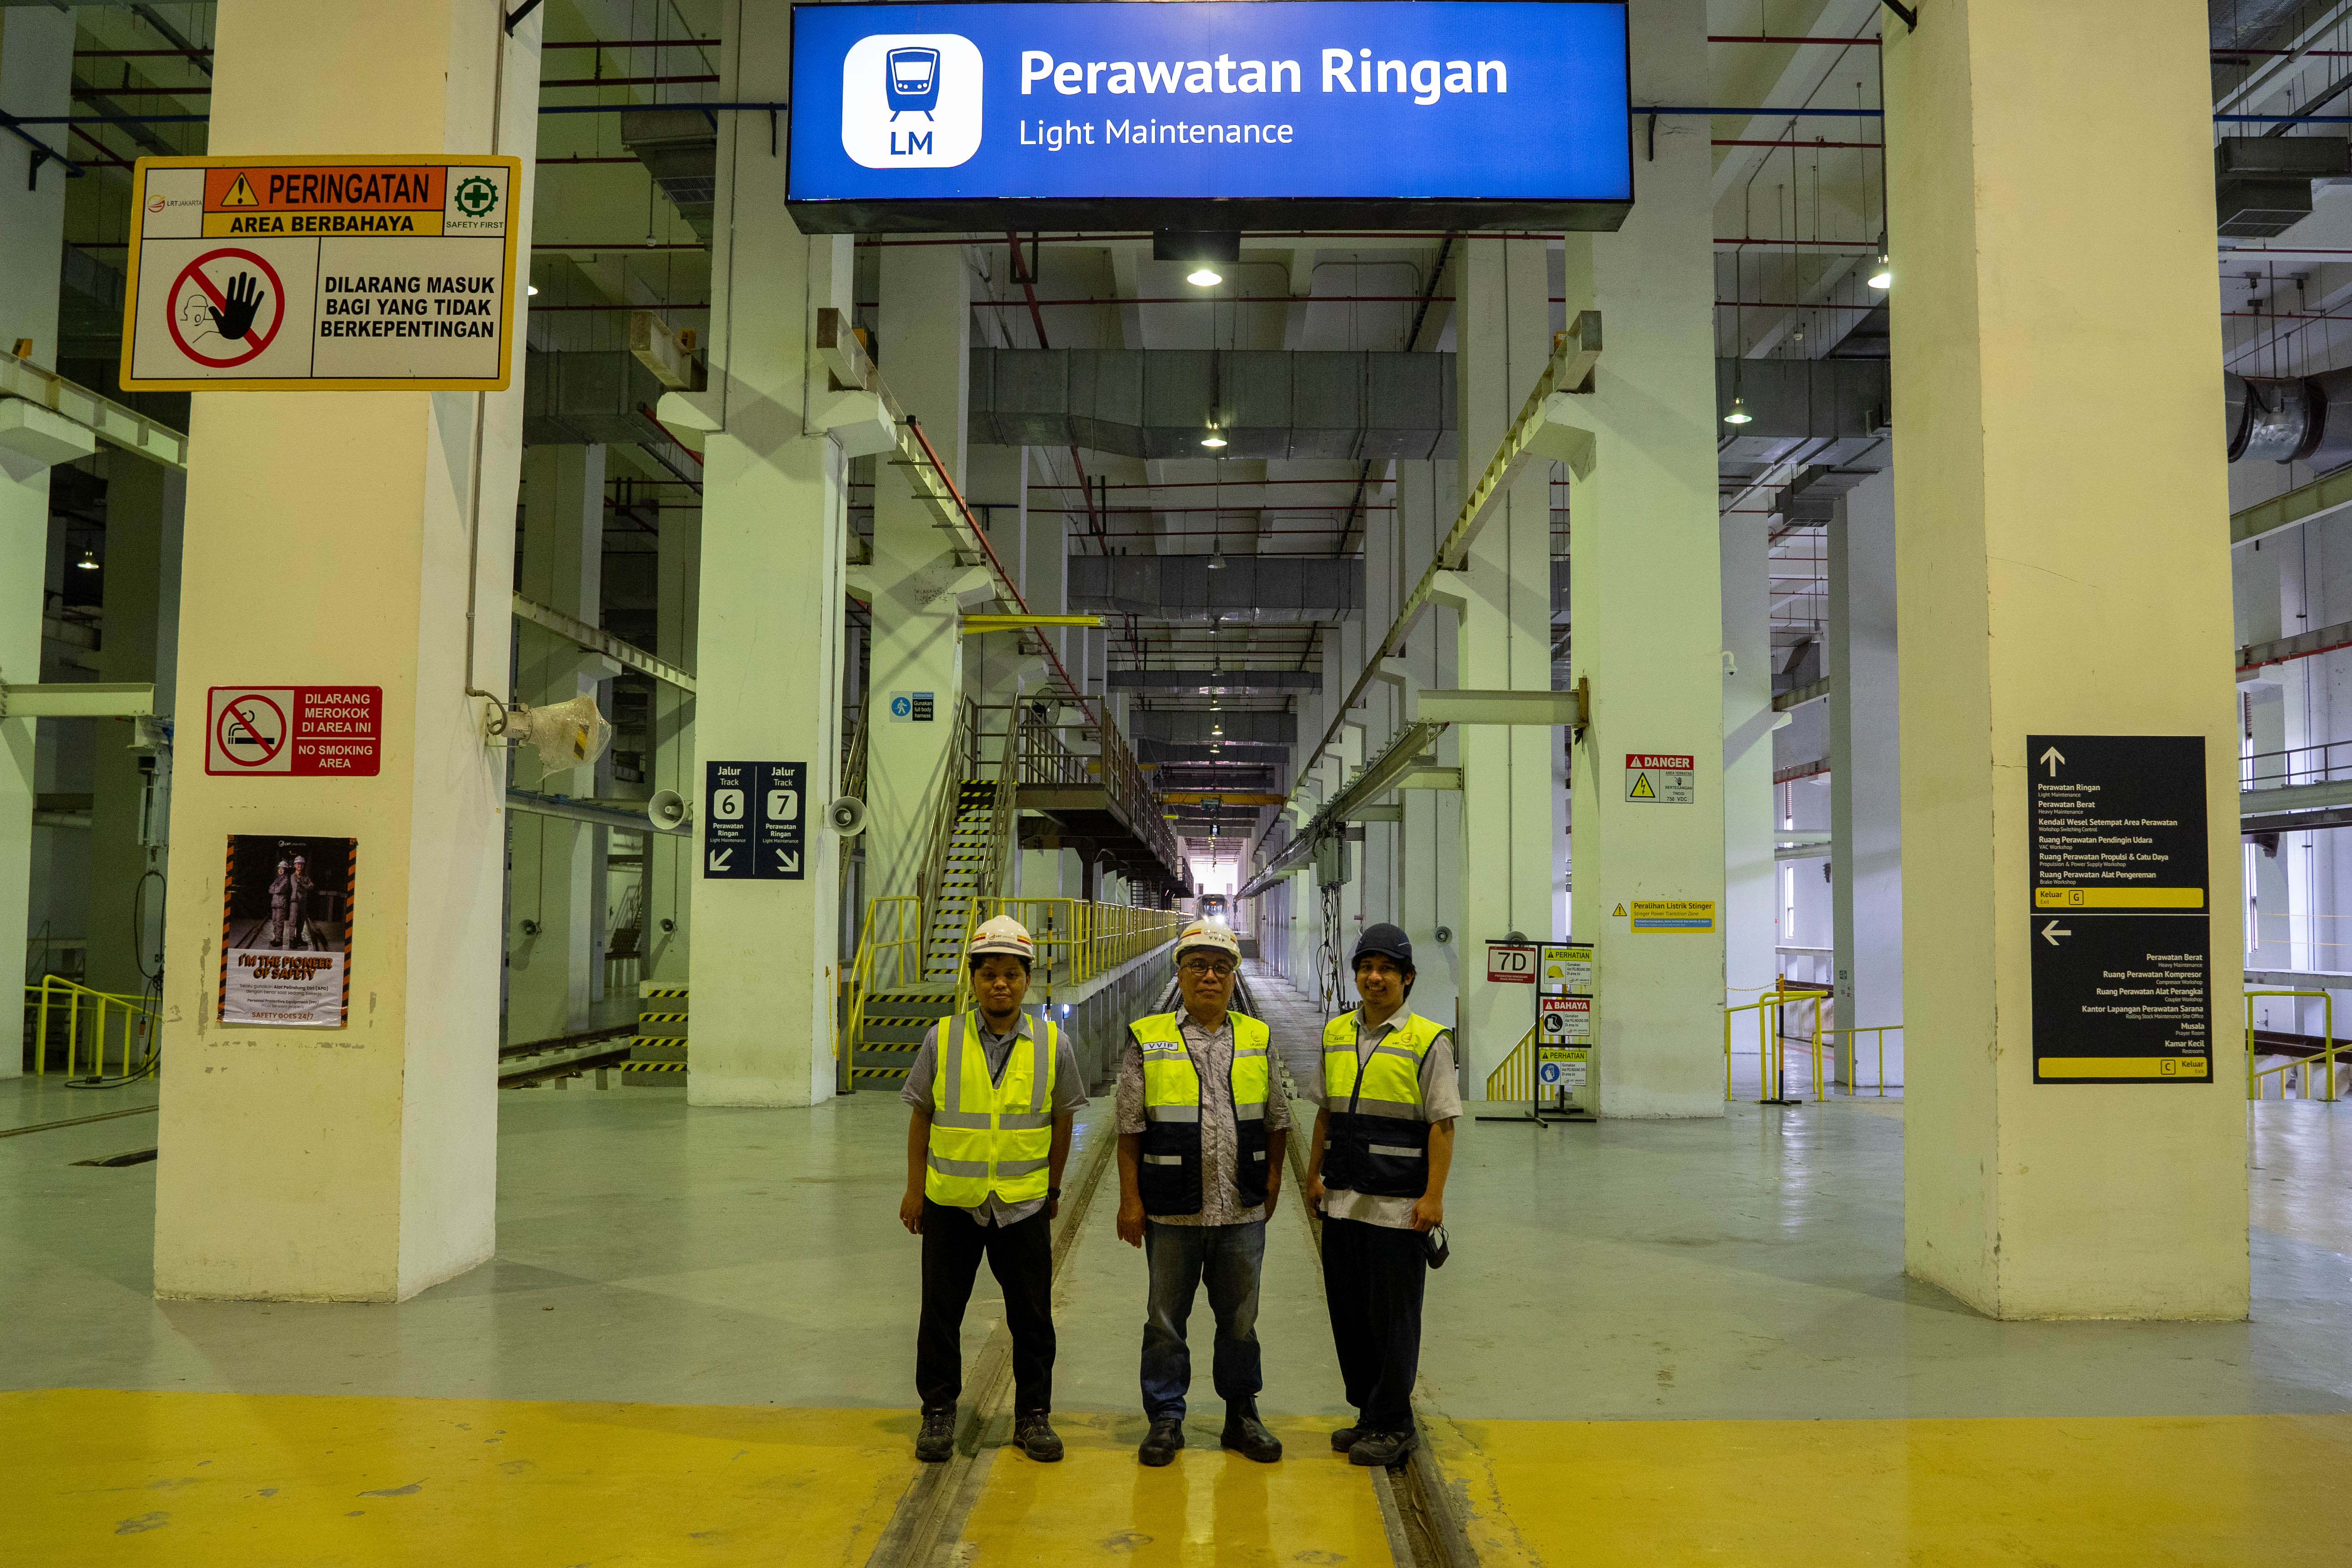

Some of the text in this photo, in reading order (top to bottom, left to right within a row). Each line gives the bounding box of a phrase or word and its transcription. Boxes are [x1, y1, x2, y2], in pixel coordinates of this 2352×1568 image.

[1020, 48, 1508, 106] Perawatan Ringan
[890, 131, 933, 157] LM
[1020, 119, 1294, 152] Light Maintenance
[269, 173, 429, 204] PERINGATAN
[230, 216, 414, 233] AREA BERBAHAYA
[325, 277, 495, 294] DILARANG MASUK
[326, 299, 491, 316] BAGI YANG TIDAK
[321, 322, 494, 338] BERKEPENTINGAN
[305, 694, 370, 704] DILARANG
[305, 708, 369, 718] MEROKOK
[302, 723, 371, 732] DI AREA INI
[299, 745, 372, 755] NO SMOKING
[319, 759, 351, 768] AREA
[718, 766, 741, 775] Jalur
[1645, 757, 1690, 768] DANGER
[771, 767, 795, 776] Jalur
[723, 795, 735, 814] 6
[777, 795, 790, 814] 7
[238, 953, 332, 970] I'M THE PIONEER
[1498, 952, 1526, 971] 7D
[253, 967, 317, 980] OF SAFETY
